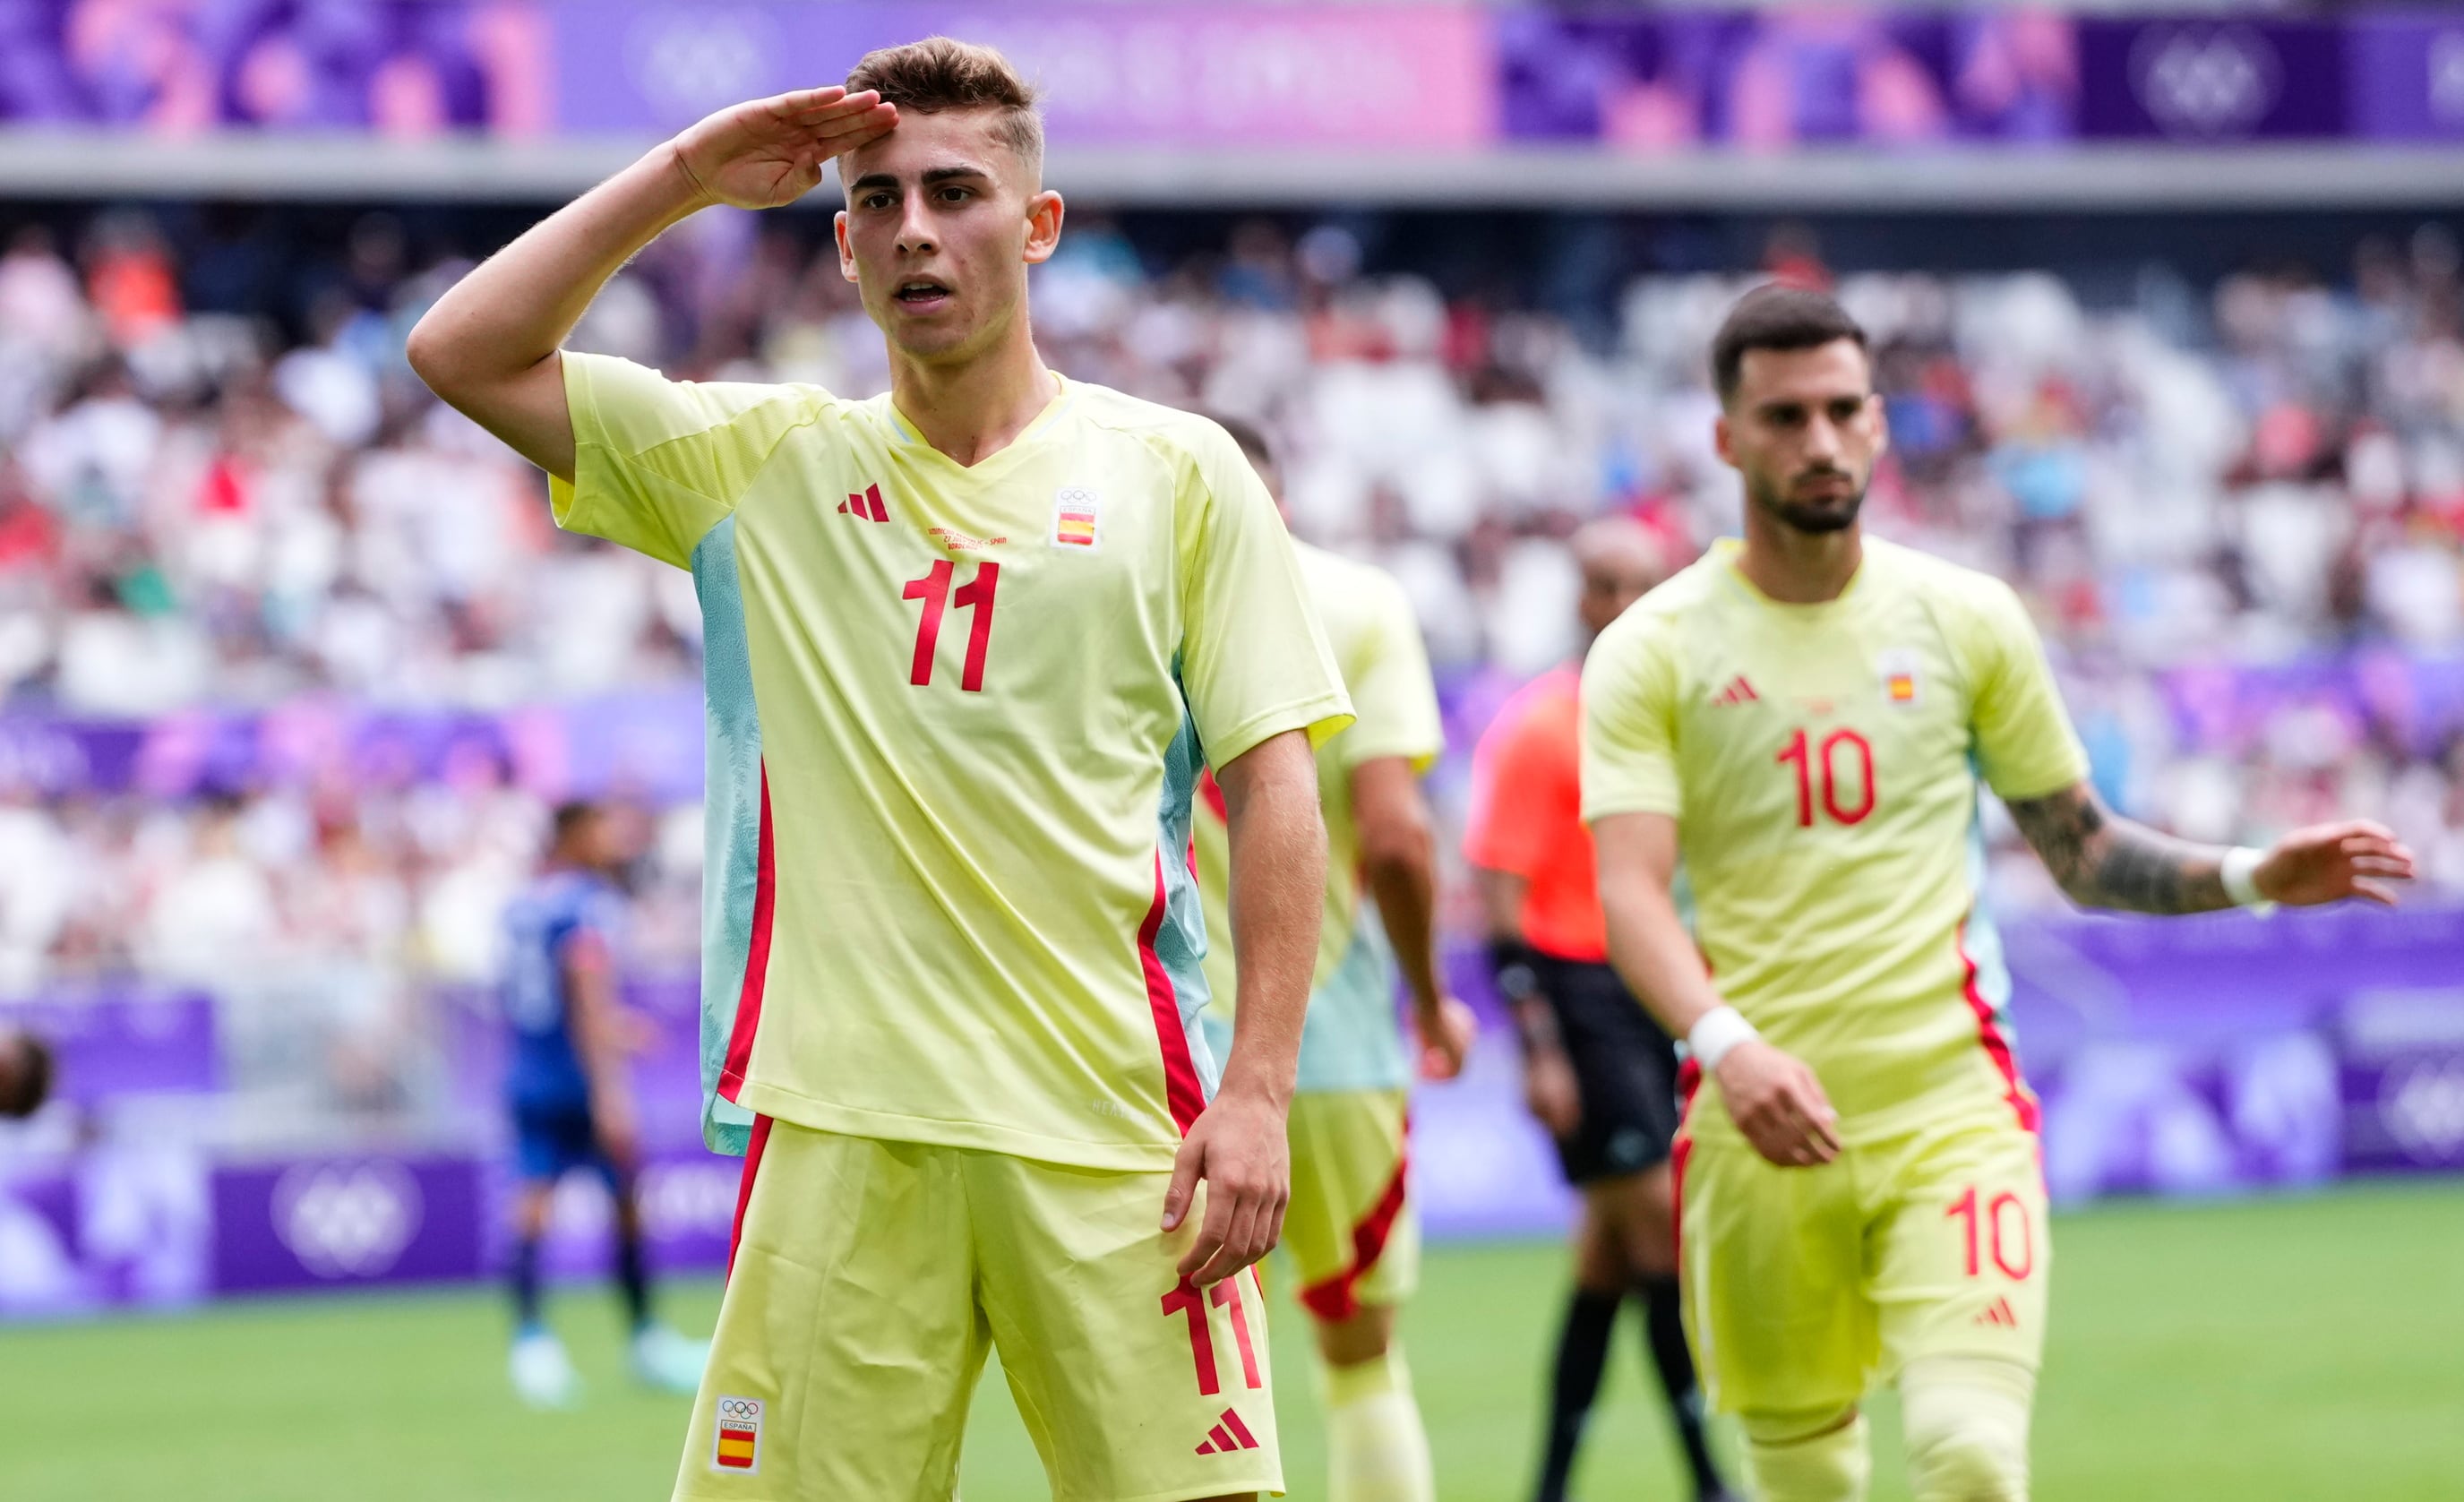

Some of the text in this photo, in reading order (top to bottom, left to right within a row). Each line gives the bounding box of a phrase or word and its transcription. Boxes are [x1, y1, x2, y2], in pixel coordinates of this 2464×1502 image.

[902, 559, 1000, 691] 11
[1776, 727, 1876, 828] 10
[1945, 1189, 2032, 1281] 10
[1161, 1271, 1262, 1395] 11
[724, 1421, 753, 1431] ESPAÑA
